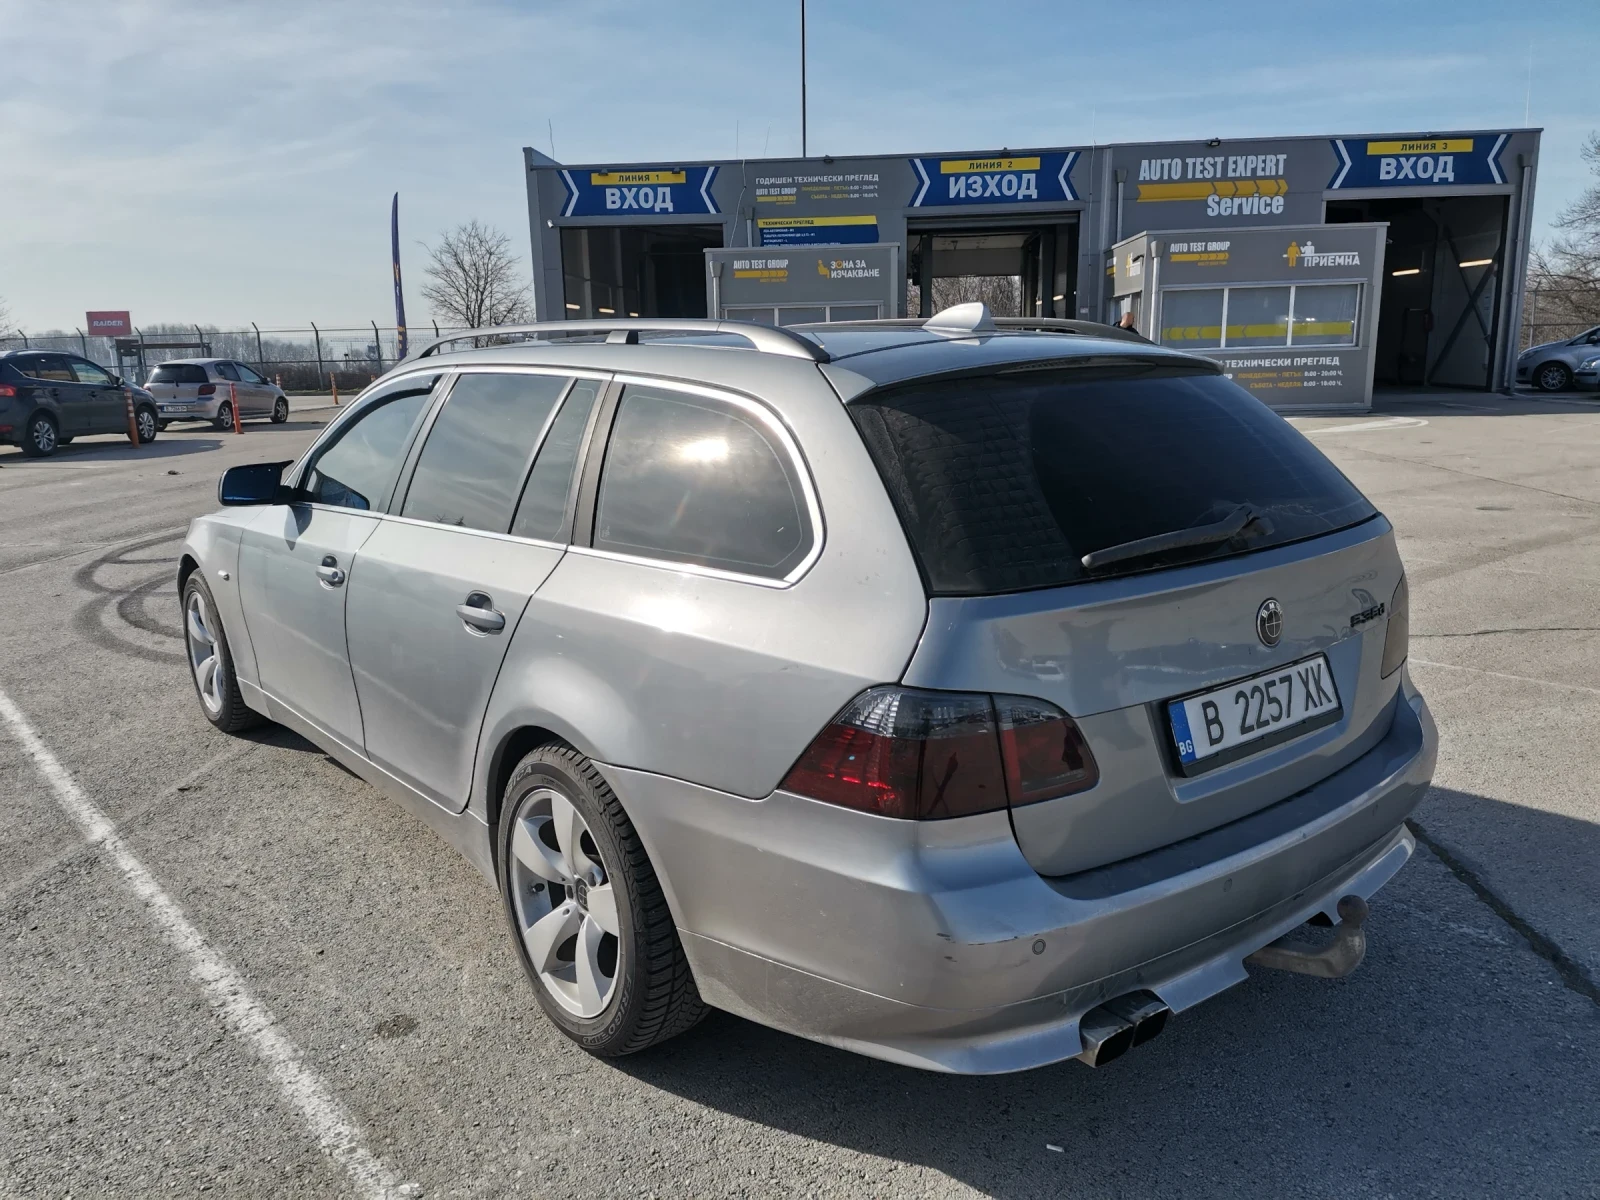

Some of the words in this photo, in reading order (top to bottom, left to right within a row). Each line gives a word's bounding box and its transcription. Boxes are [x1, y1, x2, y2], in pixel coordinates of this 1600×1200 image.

[1401, 143, 1436, 151] ЛИНИЯ
[969, 162, 1002, 170] ЛИНИЯ
[1138, 158, 1182, 181] AUTO
[1186, 156, 1225, 179] TEST
[1227, 154, 1287, 177] EXPERT
[1380, 155, 1455, 183] ВХОД
[618, 174, 650, 182] ЛИНИЯ
[756, 177, 793, 185] ГОДИШЕН
[794, 175, 843, 183] ТЕХНИЧЕСКИ
[845, 174, 879, 182] ПРЕГЛЕД
[781, 187, 797, 195] GROUP
[949, 173, 1038, 200] ИЗХОД
[605, 187, 673, 212] ВХОД
[1207, 193, 1284, 217] Service
[1170, 243, 1188, 253] AUTO
[1189, 242, 1206, 252] TEST
[1207, 241, 1230, 251] GROUP
[733, 260, 750, 269] AUTO
[751, 260, 766, 269] TEST
[767, 259, 789, 268] GROUP
[830, 260, 854, 269] ЗОНА
[855, 260, 866, 268] ЗА
[1304, 255, 1361, 267] ПРИЕМНА
[831, 269, 880, 278] ИЗЧАКВАНЕ
[1225, 358, 1291, 368] ТЕХНИЧЕСКИ
[1293, 357, 1340, 366] ПРЕГЛЕД
[1201, 700, 1225, 747] B
[1234, 674, 1292, 735] 2257
[1297, 663, 1333, 712] XK
[1178, 740, 1193, 756] BG
